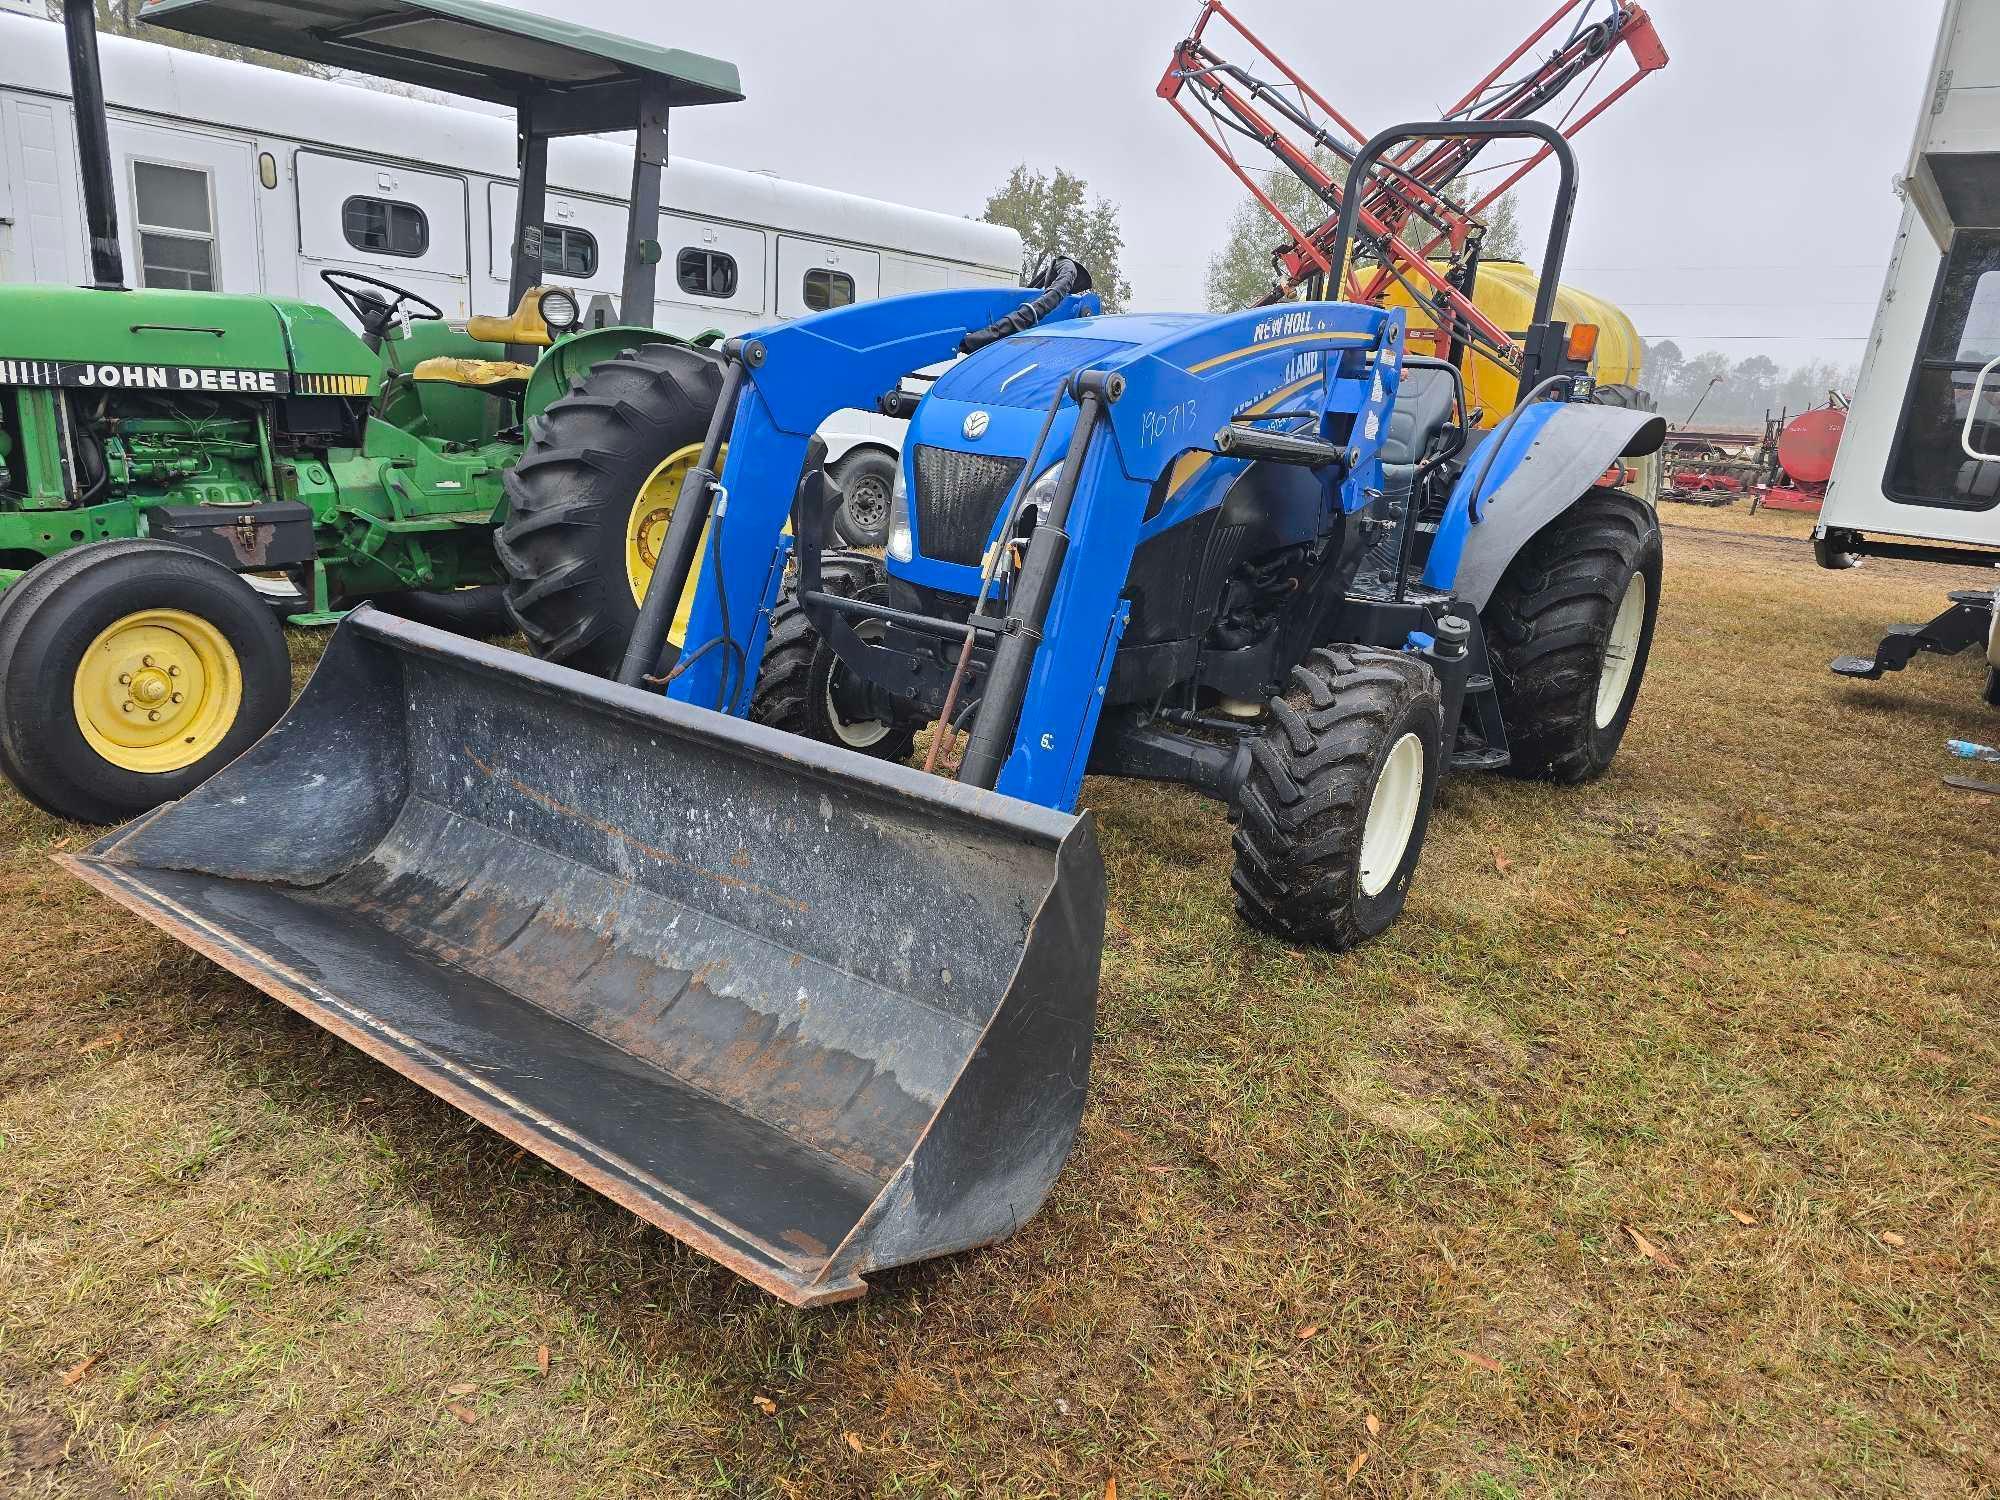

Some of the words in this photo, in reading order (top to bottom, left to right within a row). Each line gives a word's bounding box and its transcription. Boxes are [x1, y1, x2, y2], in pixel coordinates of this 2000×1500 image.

[78, 364, 168, 388] JOHN
[179, 368, 276, 391] DEERE
[1140, 399, 1197, 449] 190713
